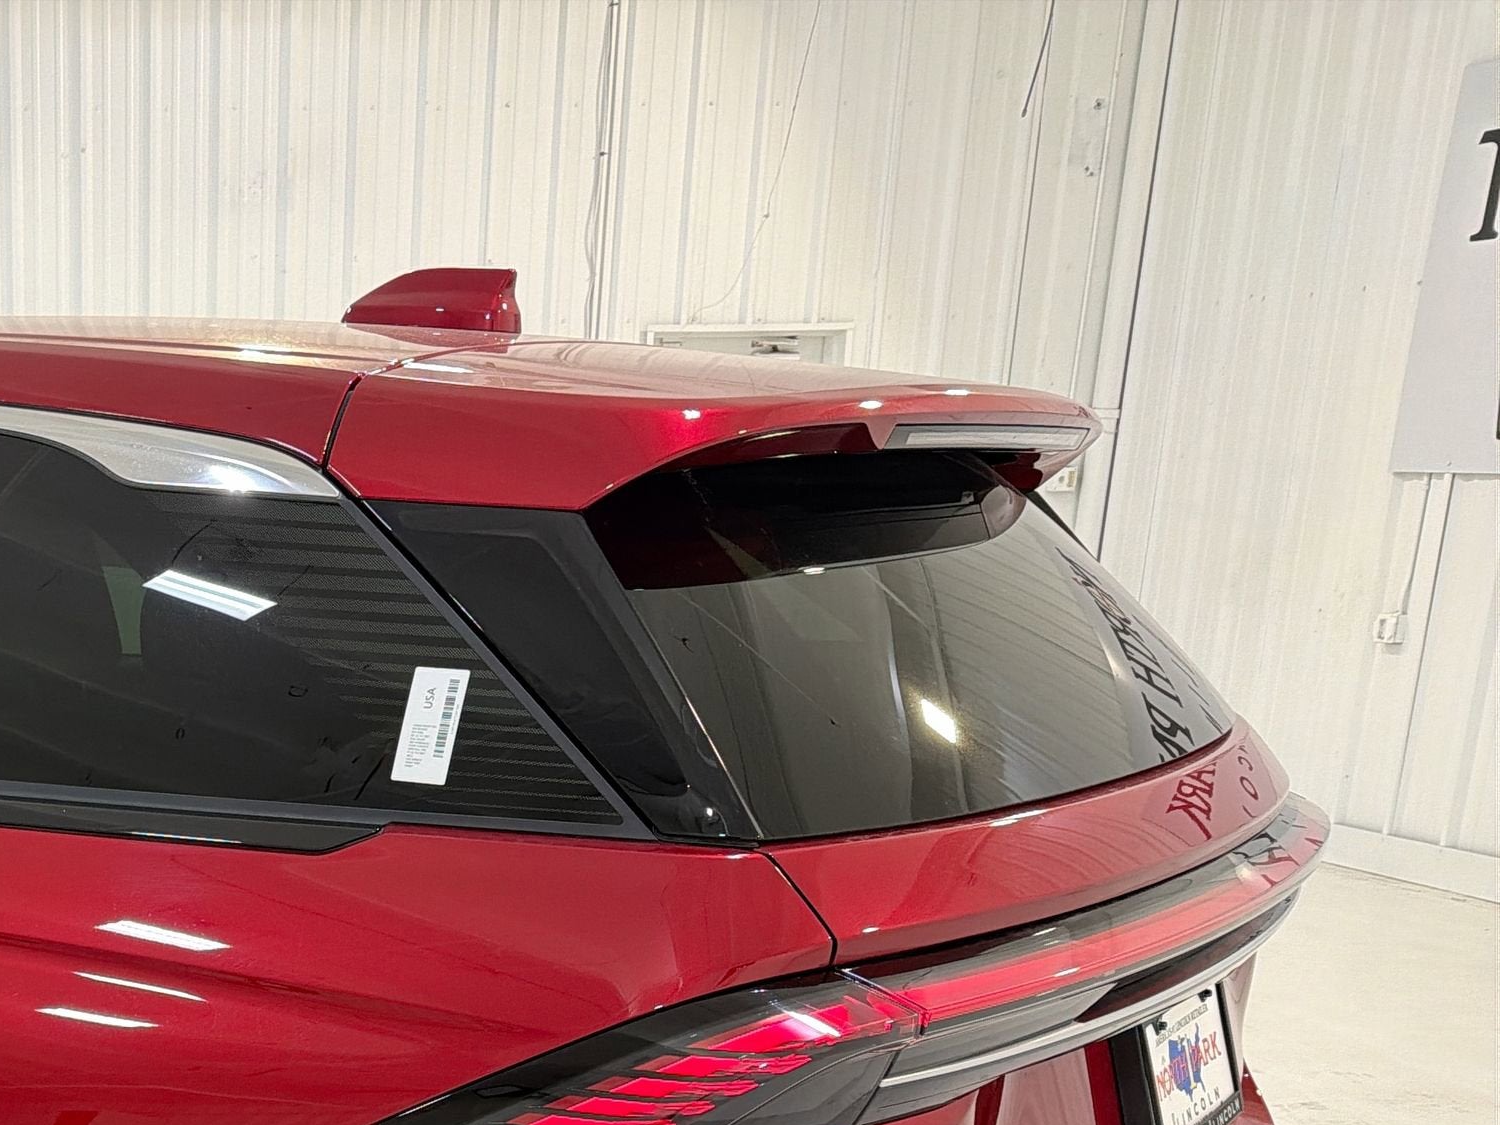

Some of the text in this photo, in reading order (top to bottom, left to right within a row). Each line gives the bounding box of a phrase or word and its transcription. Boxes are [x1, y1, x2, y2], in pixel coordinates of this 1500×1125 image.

[423, 687, 437, 710] USA
[1155, 1030, 1222, 1102] NORTH PARK
